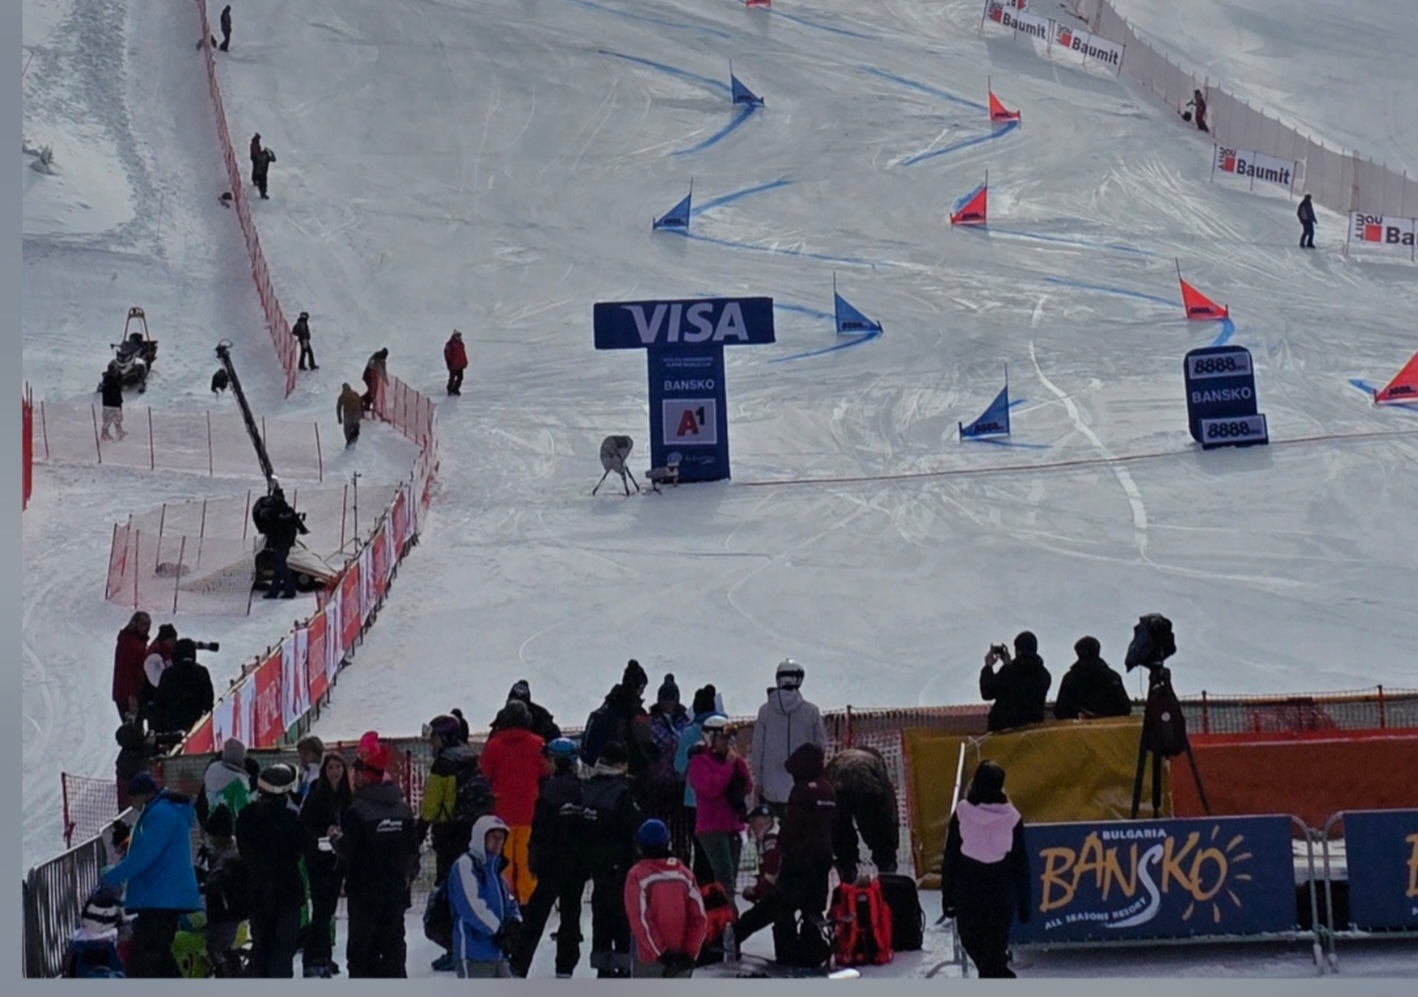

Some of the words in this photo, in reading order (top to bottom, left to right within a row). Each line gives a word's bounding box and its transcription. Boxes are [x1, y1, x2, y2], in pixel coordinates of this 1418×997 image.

[1002, 11, 1047, 40] Baumit
[1071, 36, 1119, 66] Baumit
[1236, 158, 1291, 185] Baumit
[621, 301, 750, 344] VISA
[663, 378, 715, 391] BANSKO
[1191, 386, 1252, 404] BANSKO
[676, 406, 705, 437] A1
[1102, 828, 1167, 840] BULGARIA
[1039, 831, 1228, 928] BANSKO
[1044, 918, 1063, 930] ALL
[1066, 911, 1110, 924] SEASONS
[1112, 897, 1147, 919] RESORT
